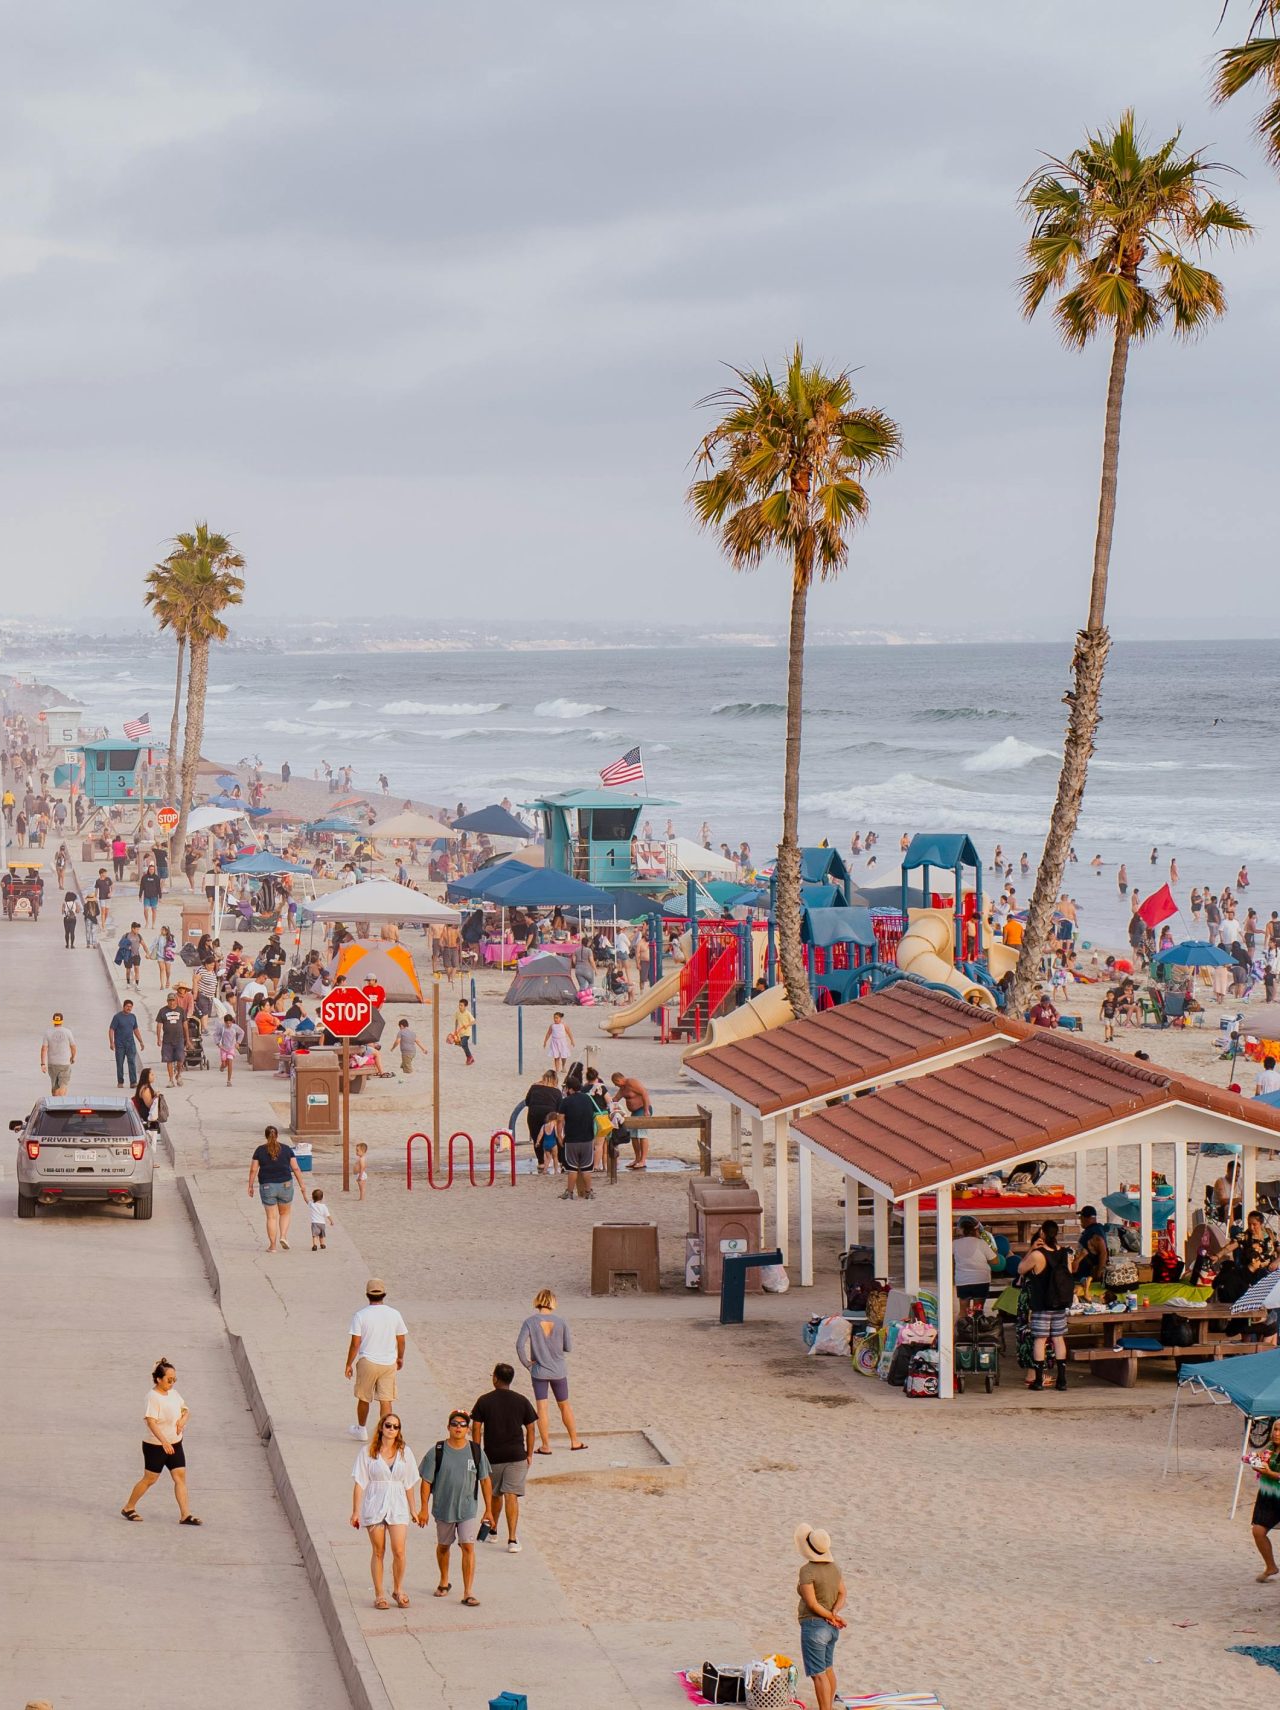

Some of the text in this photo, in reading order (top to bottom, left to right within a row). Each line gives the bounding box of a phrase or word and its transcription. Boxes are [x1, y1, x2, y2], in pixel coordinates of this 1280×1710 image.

[62, 729, 72, 741] 5
[118, 776, 126, 787] 3
[158, 814, 178, 824] STOP
[606, 848, 615, 866] 1
[324, 1002, 368, 1021] STOP
